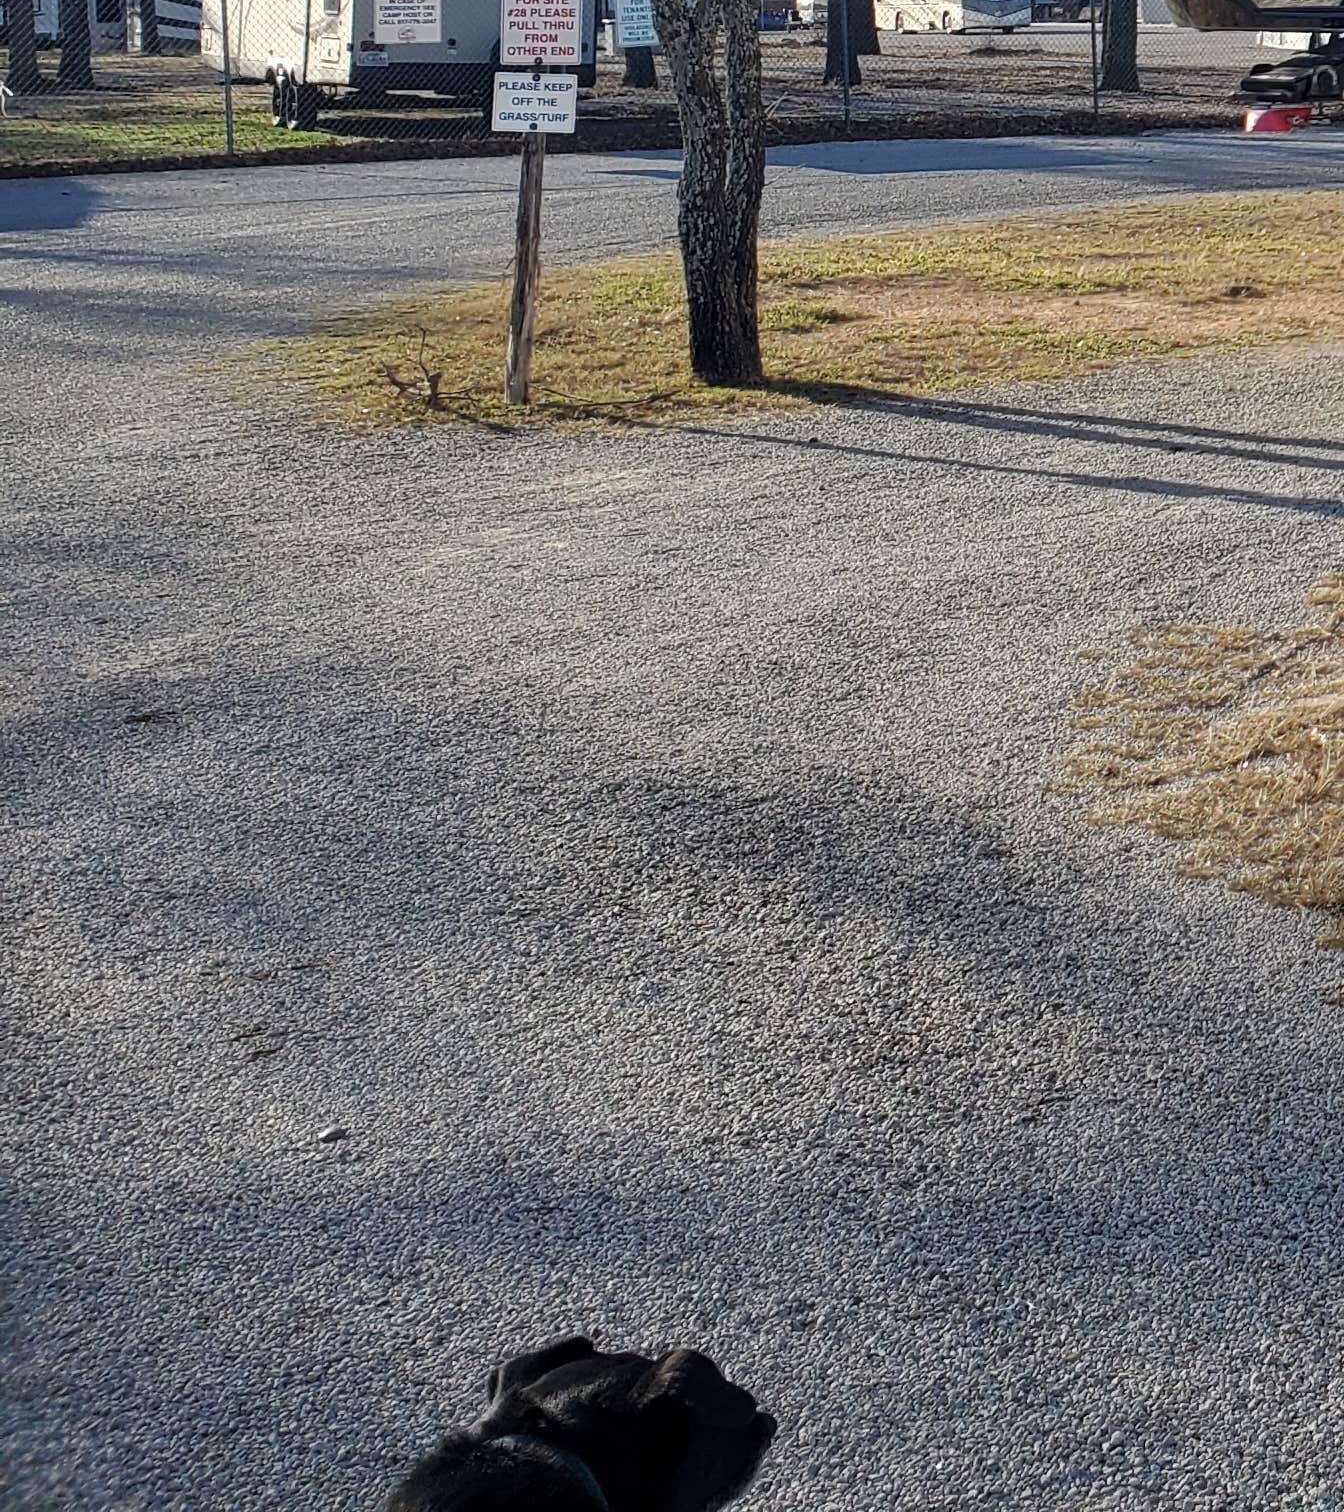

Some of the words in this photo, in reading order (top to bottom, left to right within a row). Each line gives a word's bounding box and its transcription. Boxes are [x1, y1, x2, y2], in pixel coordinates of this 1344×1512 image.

[507, 8, 527, 18] #28
[530, 8, 576, 18] PLEASE
[509, 20, 540, 30] PULL
[542, 20, 574, 30] THRU
[524, 33, 558, 43] FROM
[507, 46, 547, 56] OTHER
[551, 46, 575, 56] END
[498, 80, 541, 91] PLEASE
[544, 82, 573, 92] KEEP
[511, 96, 534, 106] OFF
[536, 97, 558, 107] THE
[498, 111, 570, 123] GRASS/TURF
